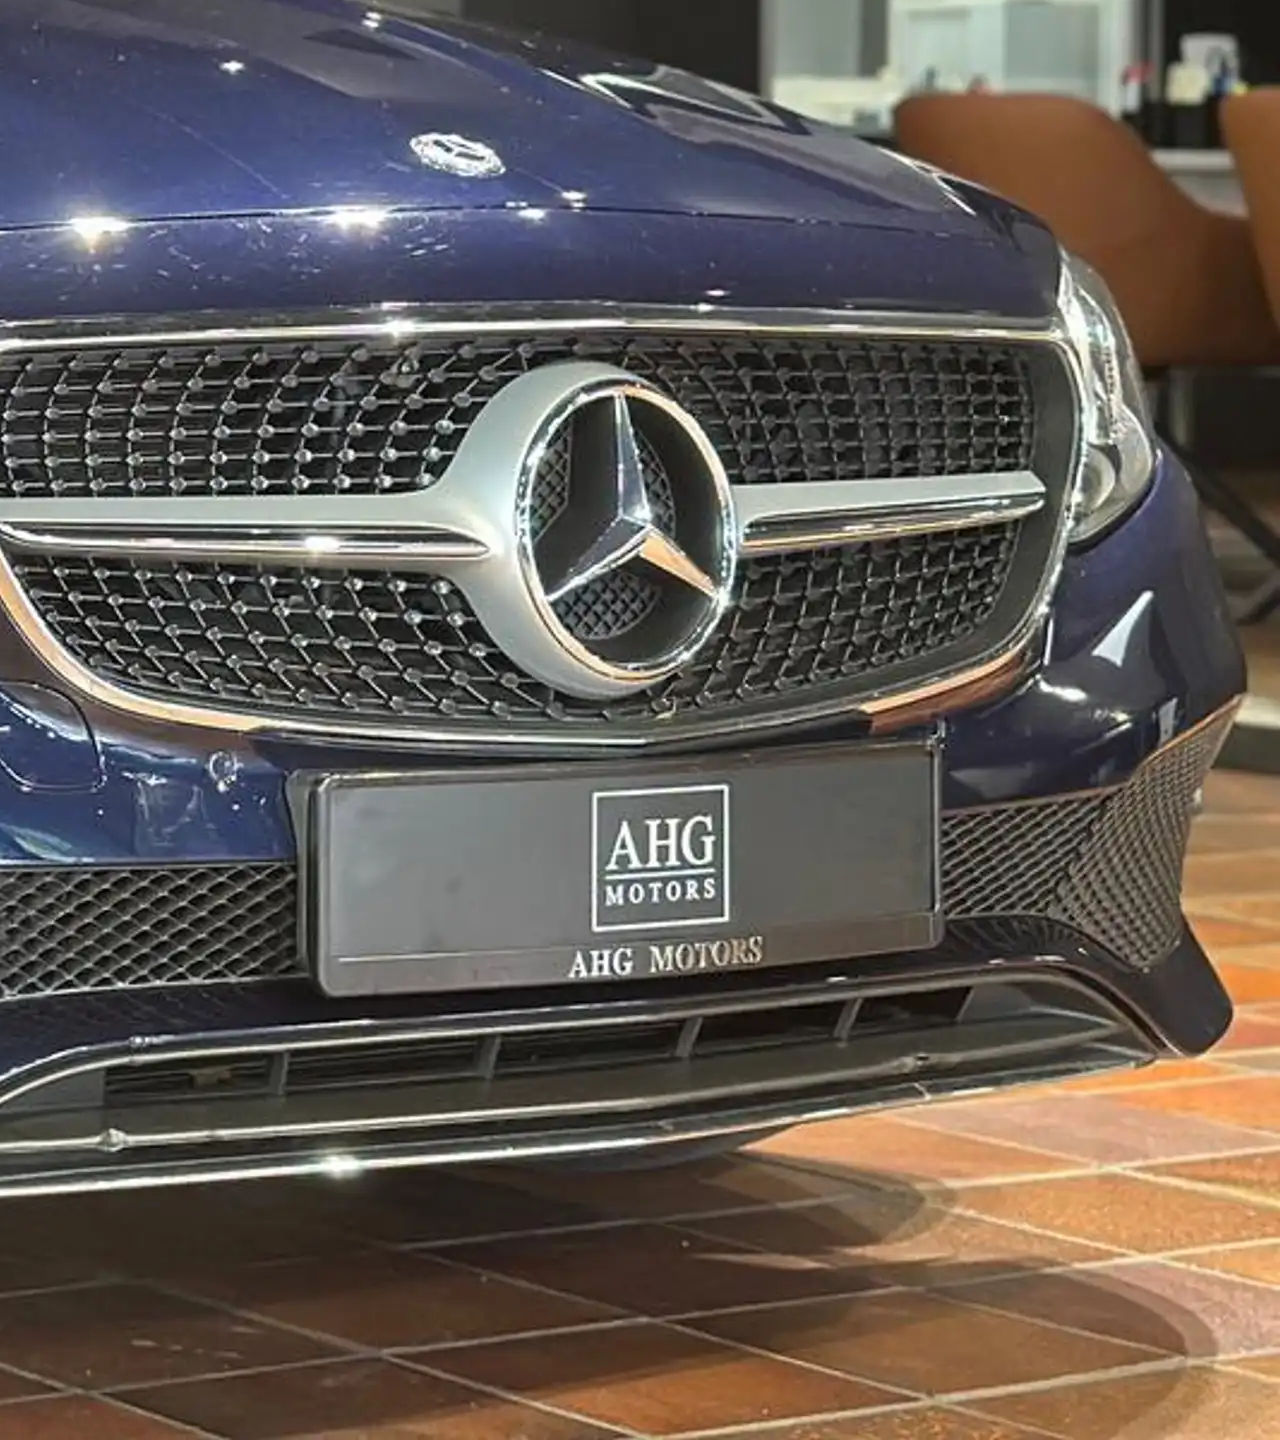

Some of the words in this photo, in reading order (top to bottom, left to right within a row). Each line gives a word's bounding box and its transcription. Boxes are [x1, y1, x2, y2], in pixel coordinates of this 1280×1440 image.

[605, 814, 716, 871] AHG
[604, 877, 716, 907] MOTORS
[568, 948, 634, 978] AHG
[649, 936, 763, 973] MOTORS
